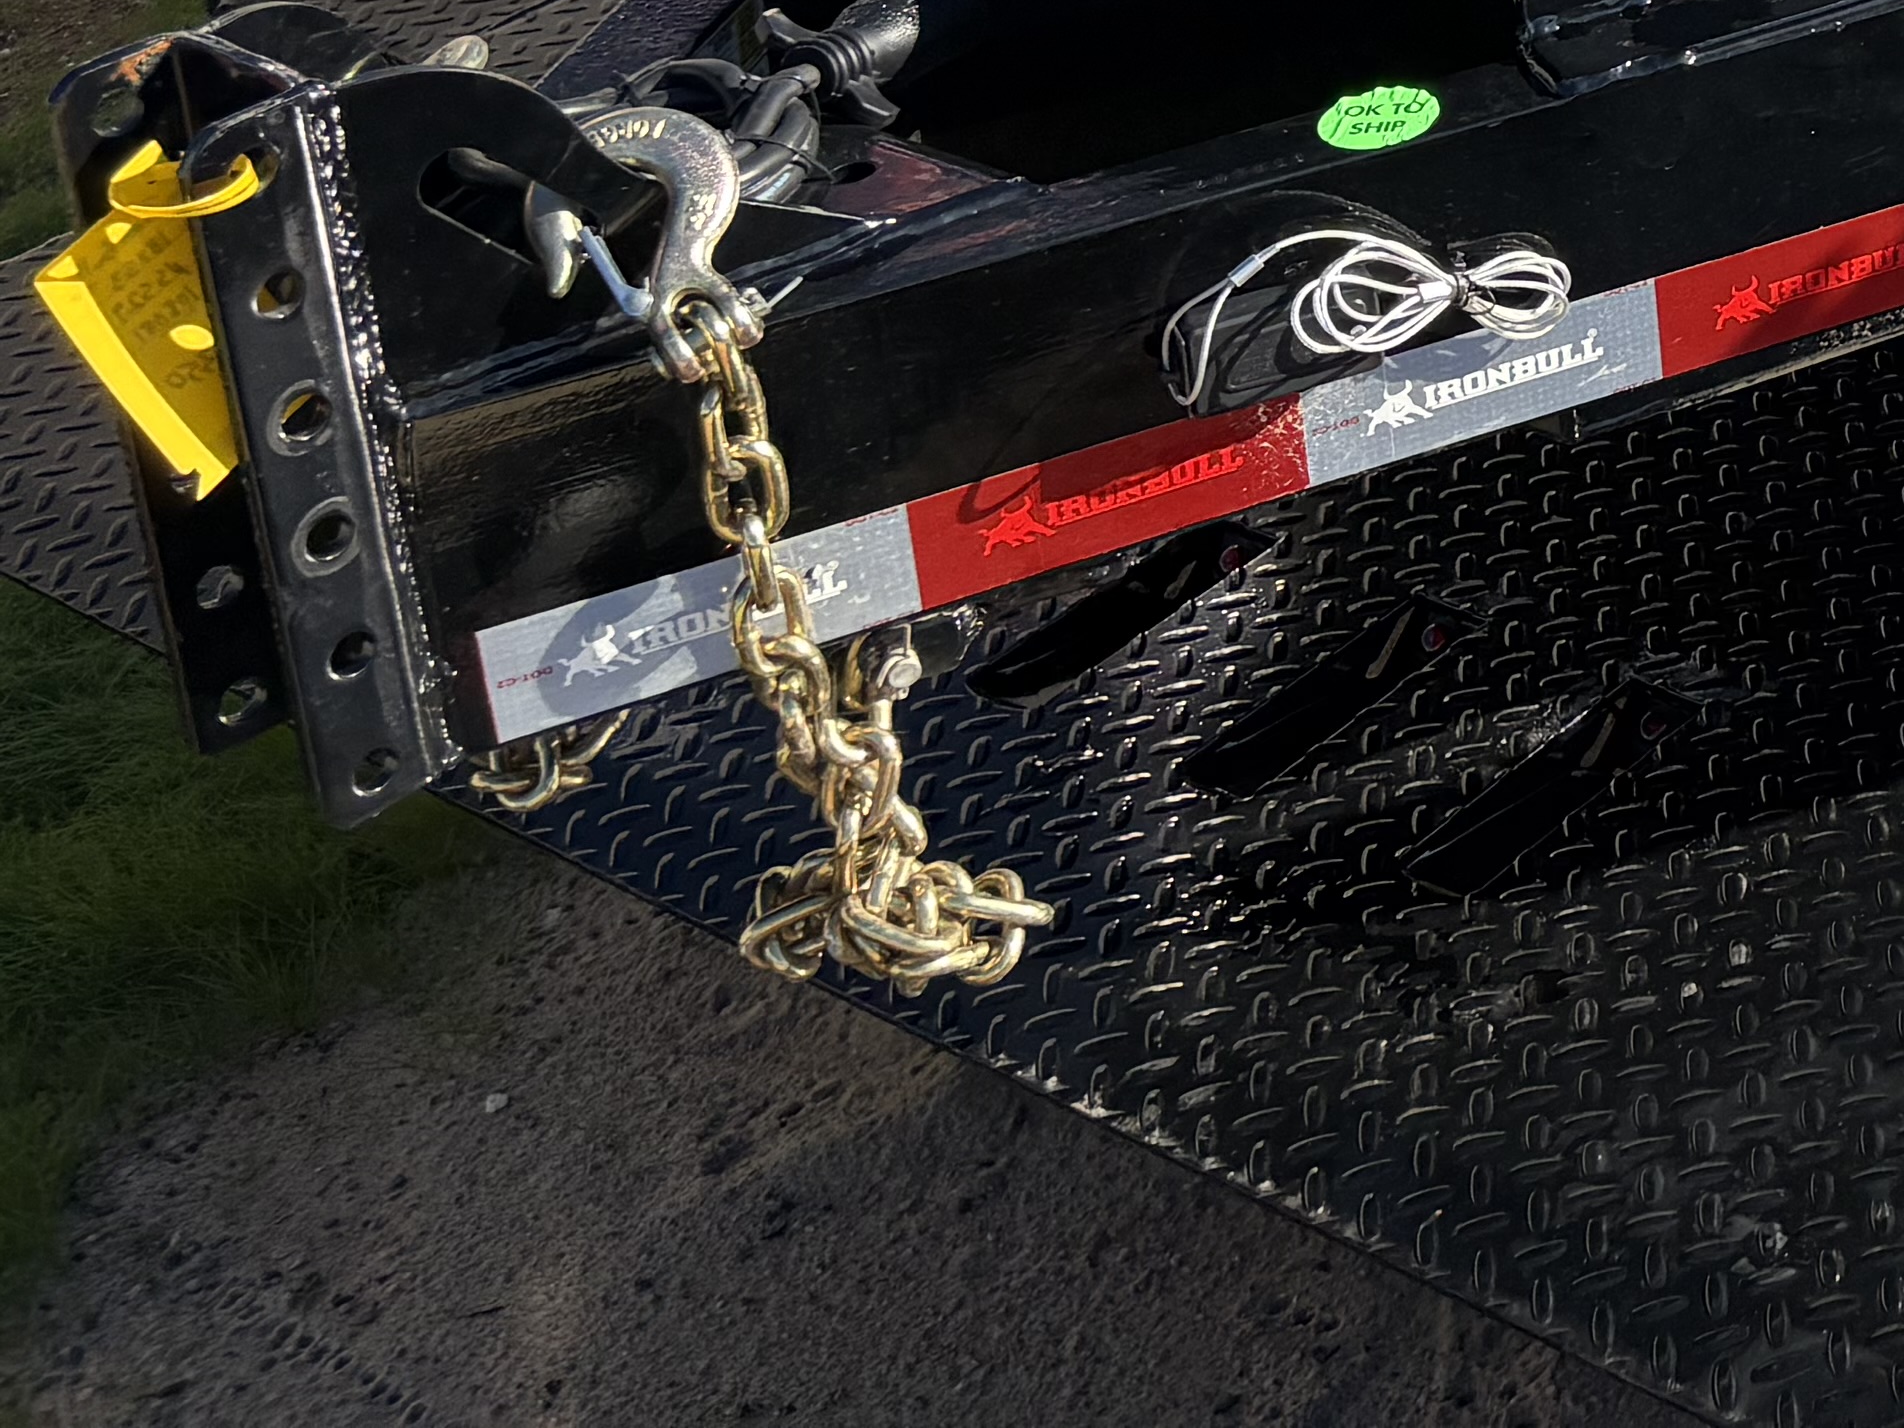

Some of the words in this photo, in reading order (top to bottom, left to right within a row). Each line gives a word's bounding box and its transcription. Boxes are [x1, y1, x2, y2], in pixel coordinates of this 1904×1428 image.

[1344, 103, 1386, 118] OK
[1391, 101, 1429, 115] TO
[1348, 119, 1407, 136] SHIP
[1423, 335, 1604, 410] IRONBULL
[1045, 443, 1245, 528] IRONBULL
